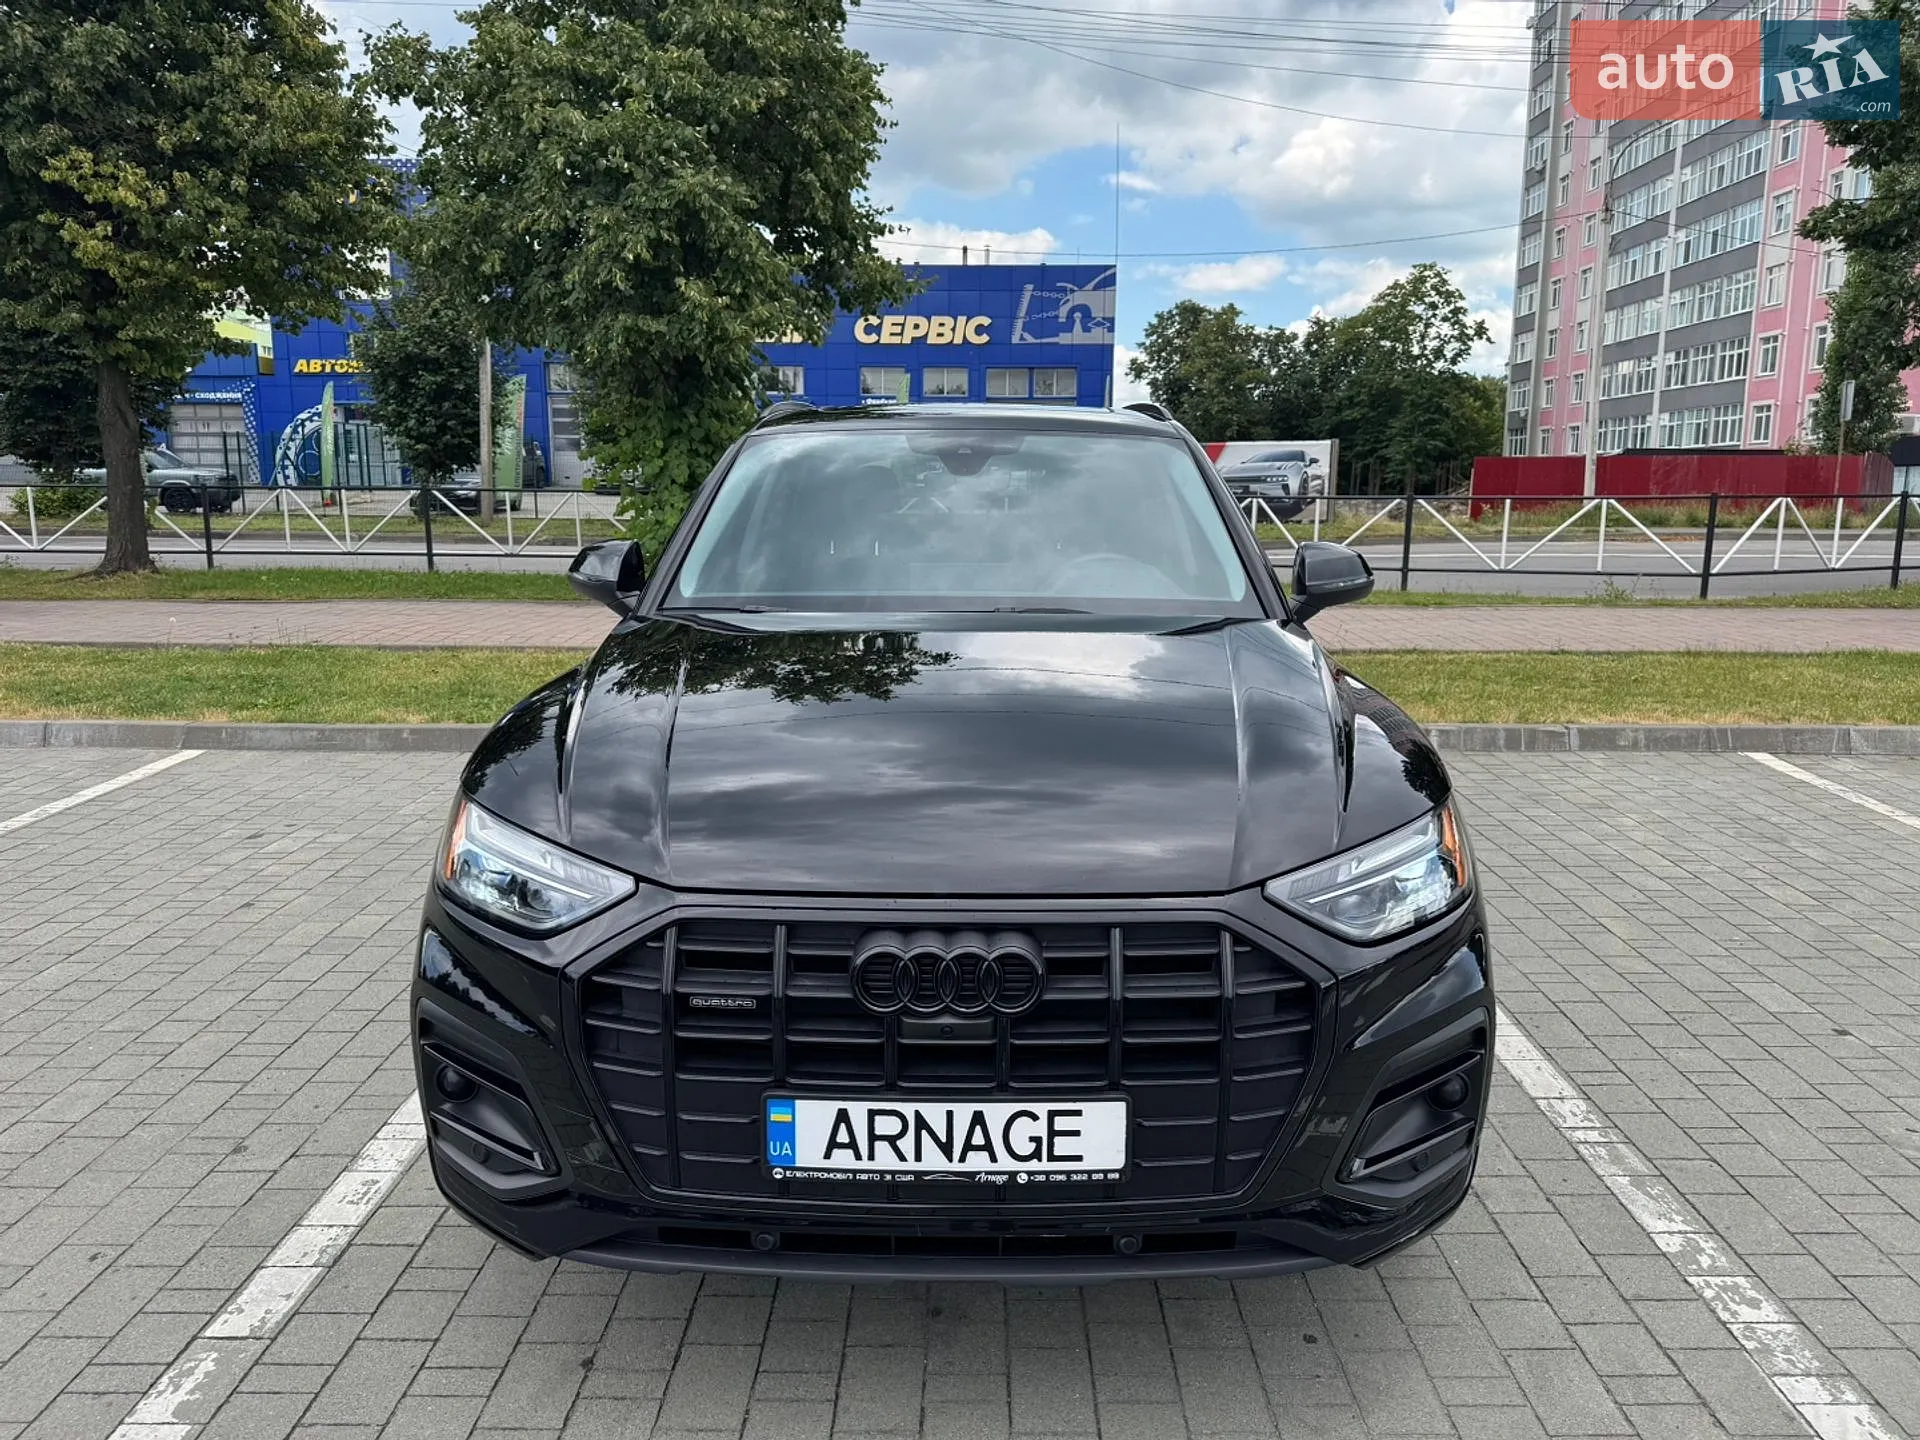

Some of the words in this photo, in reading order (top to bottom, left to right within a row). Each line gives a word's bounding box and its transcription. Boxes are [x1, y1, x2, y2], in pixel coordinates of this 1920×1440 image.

[854, 315, 992, 345] СЕРВІС
[692, 998, 753, 1008] quattro
[822, 1107, 1084, 1164] ARNAGE
[769, 1140, 792, 1157] UA
[856, 1173, 880, 1181] АВТО
[974, 1171, 1009, 1185] Arnage
[1049, 1174, 1067, 1182] 096
